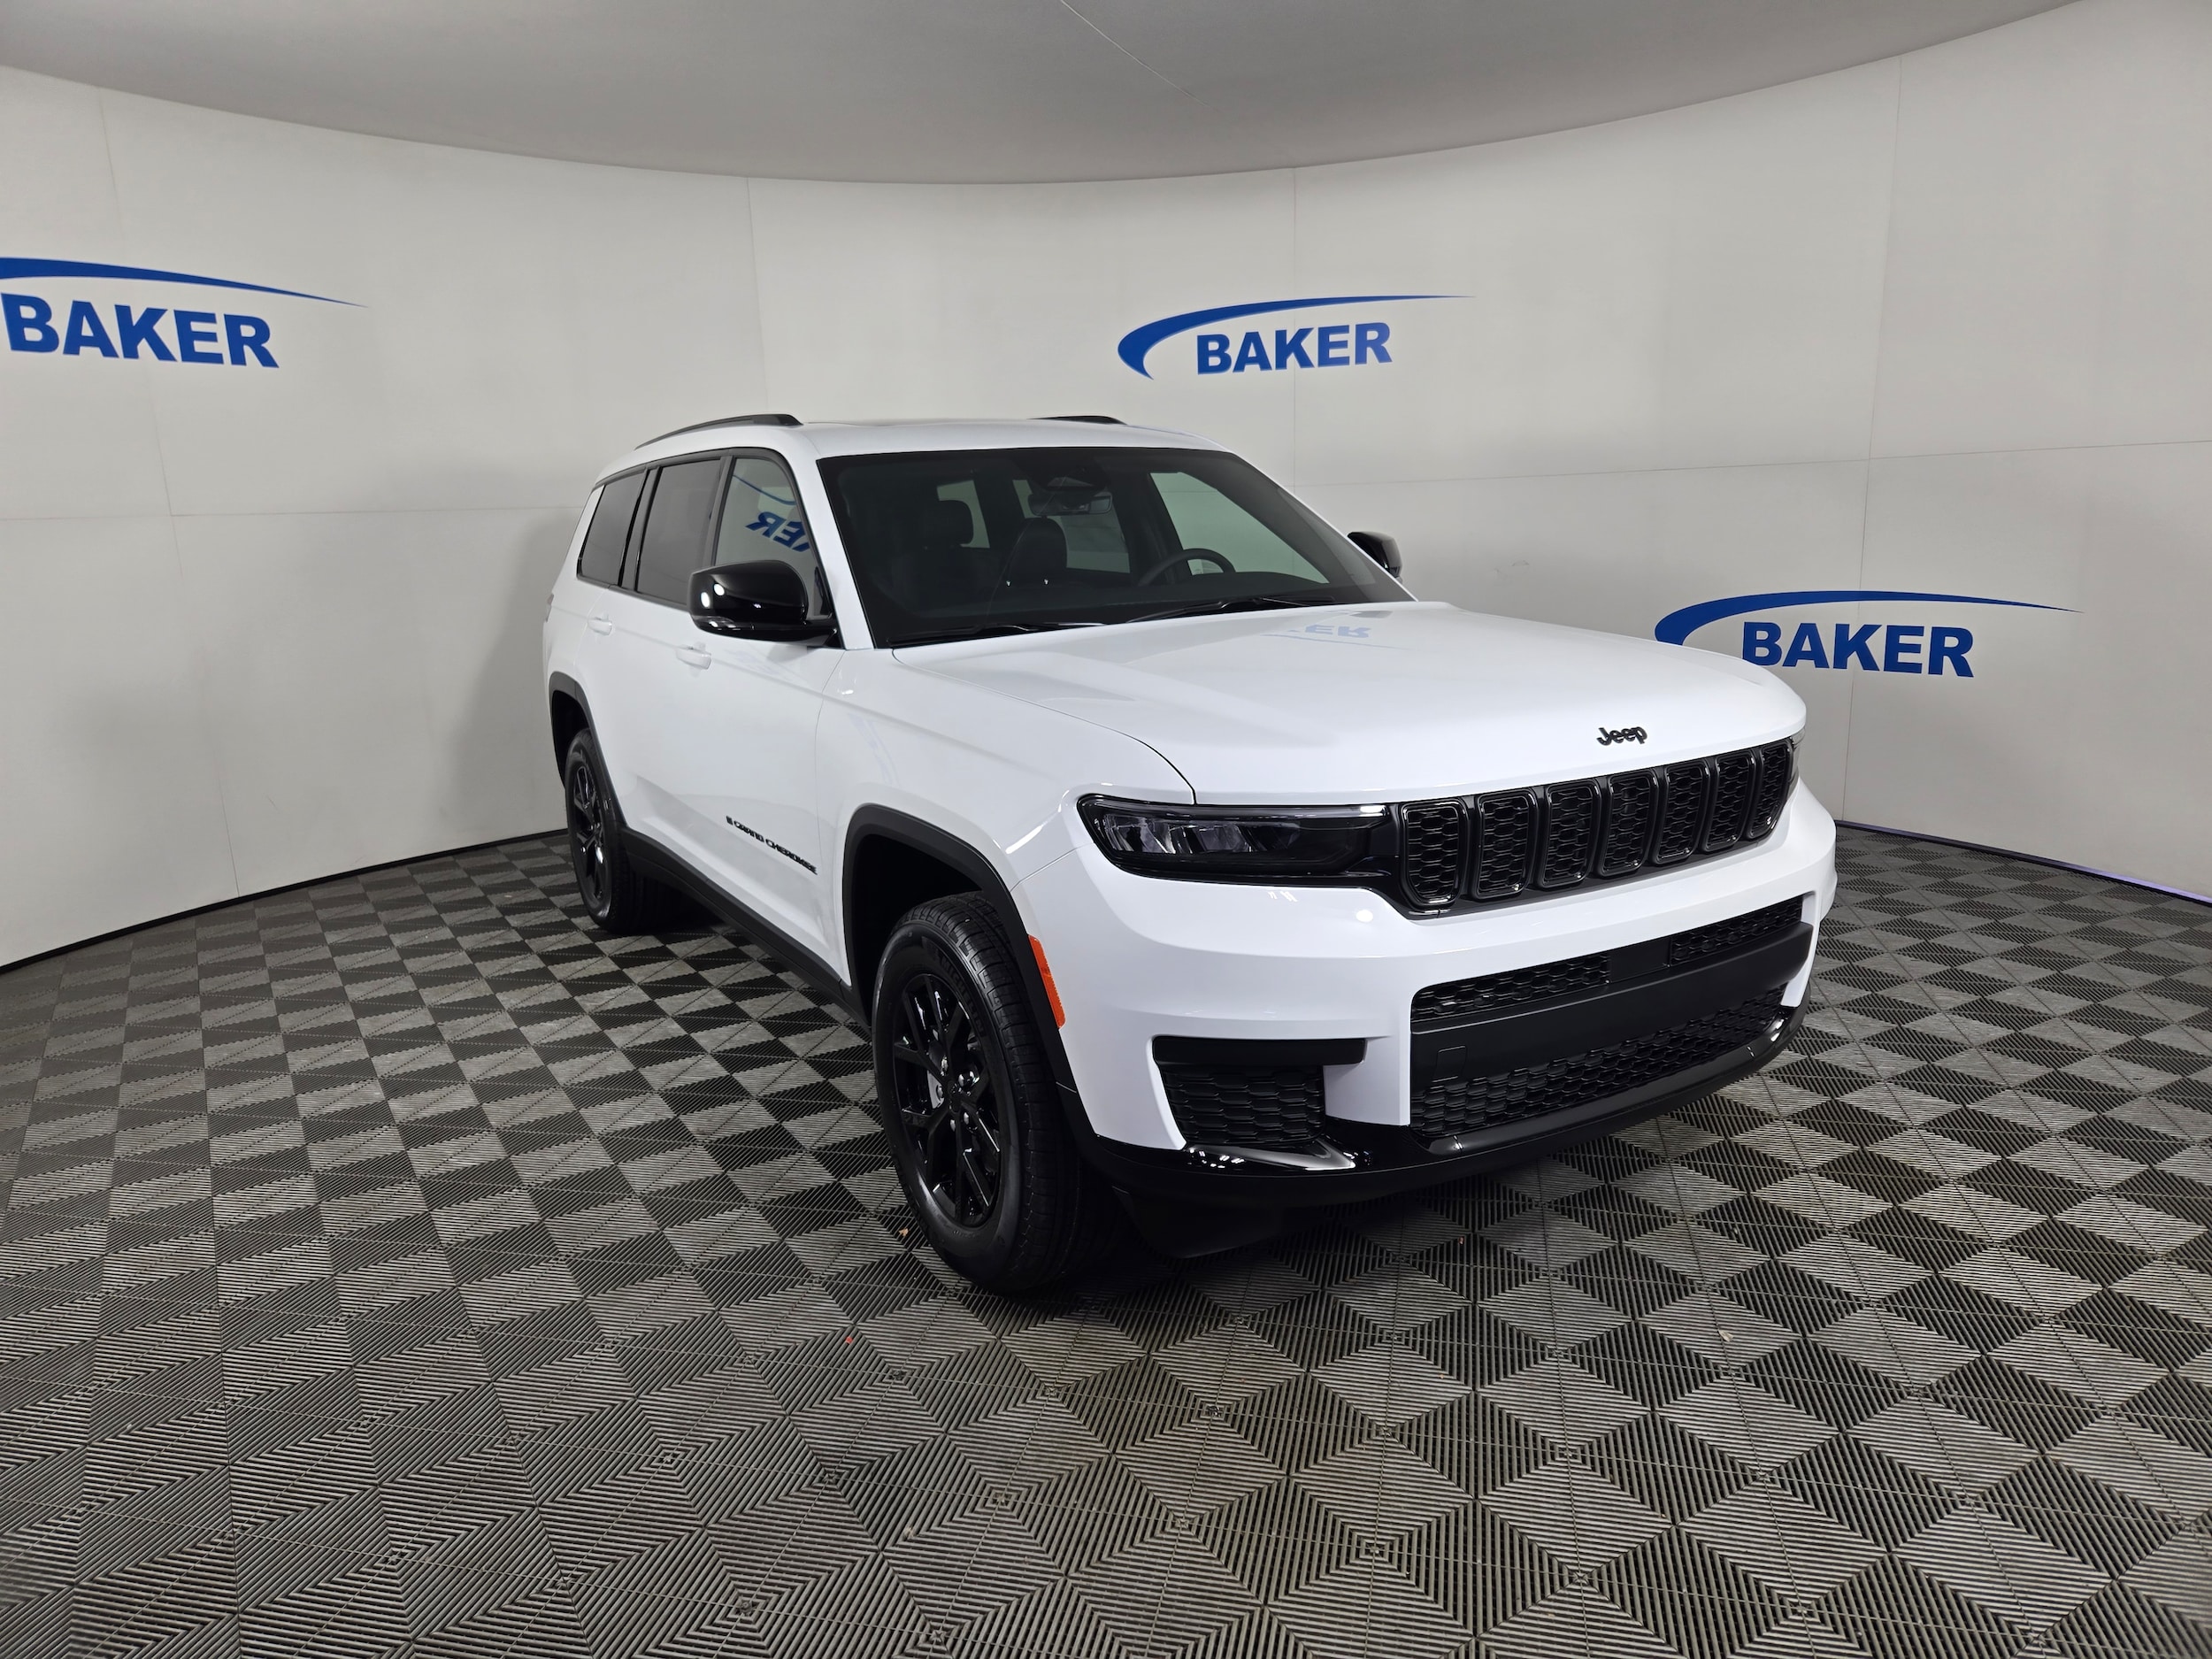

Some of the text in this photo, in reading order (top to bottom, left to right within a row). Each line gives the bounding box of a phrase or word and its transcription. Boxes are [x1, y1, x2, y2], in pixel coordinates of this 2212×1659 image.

[1, 293, 279, 368] BAKER
[1197, 322, 1393, 375] BAKER
[1742, 621, 1974, 678] BAKER
[1596, 726, 1647, 746] Jeep
[733, 820, 764, 842] GRAND
